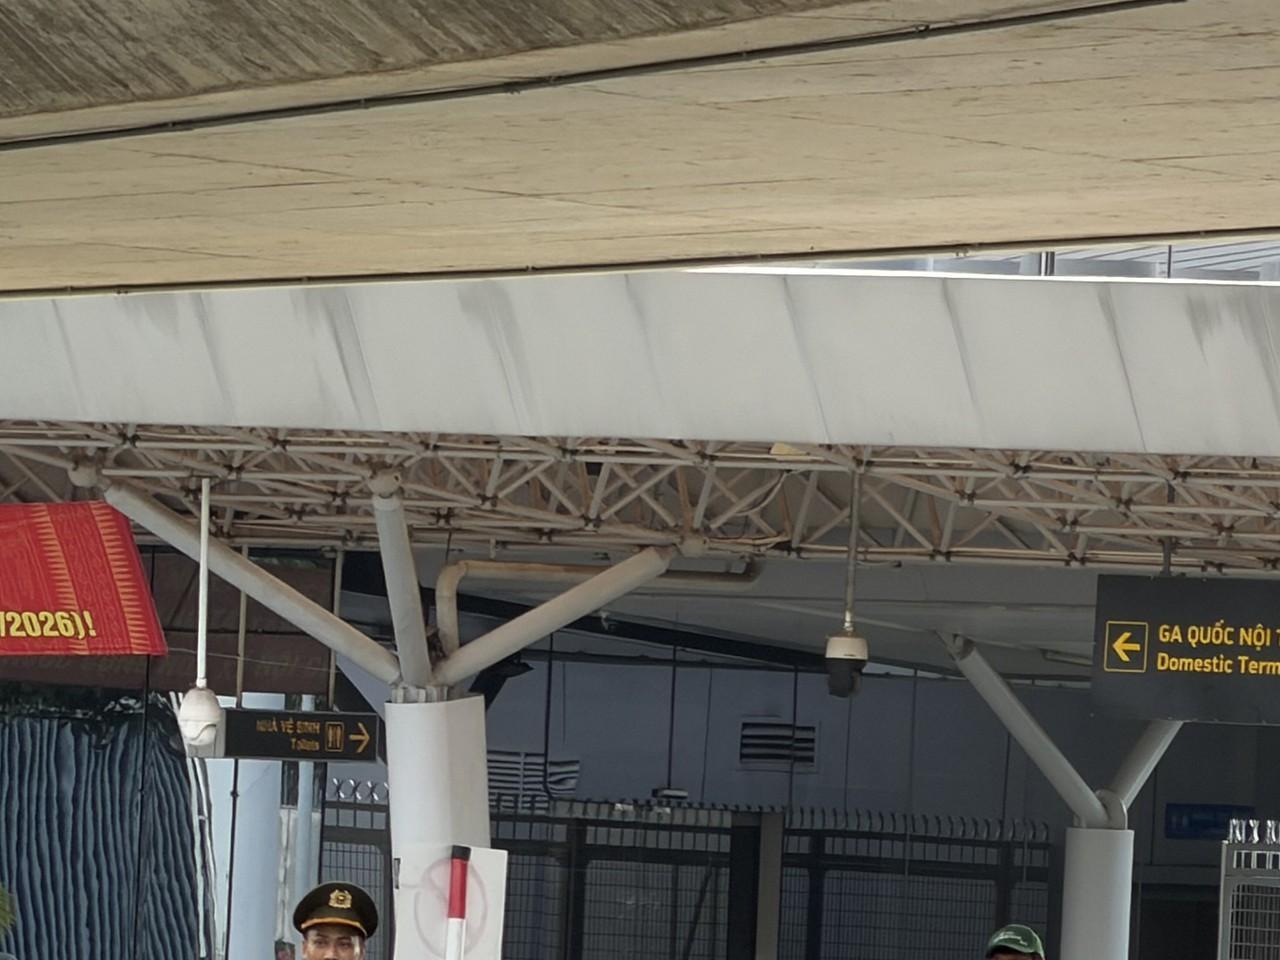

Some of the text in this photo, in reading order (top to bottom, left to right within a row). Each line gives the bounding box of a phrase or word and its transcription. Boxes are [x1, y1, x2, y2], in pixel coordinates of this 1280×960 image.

[1158, 624, 1183, 643] GA
[1187, 619, 1235, 648] QUỐC
[1239, 623, 1271, 651] NỘI
[1156, 652, 1233, 673] Domestic
